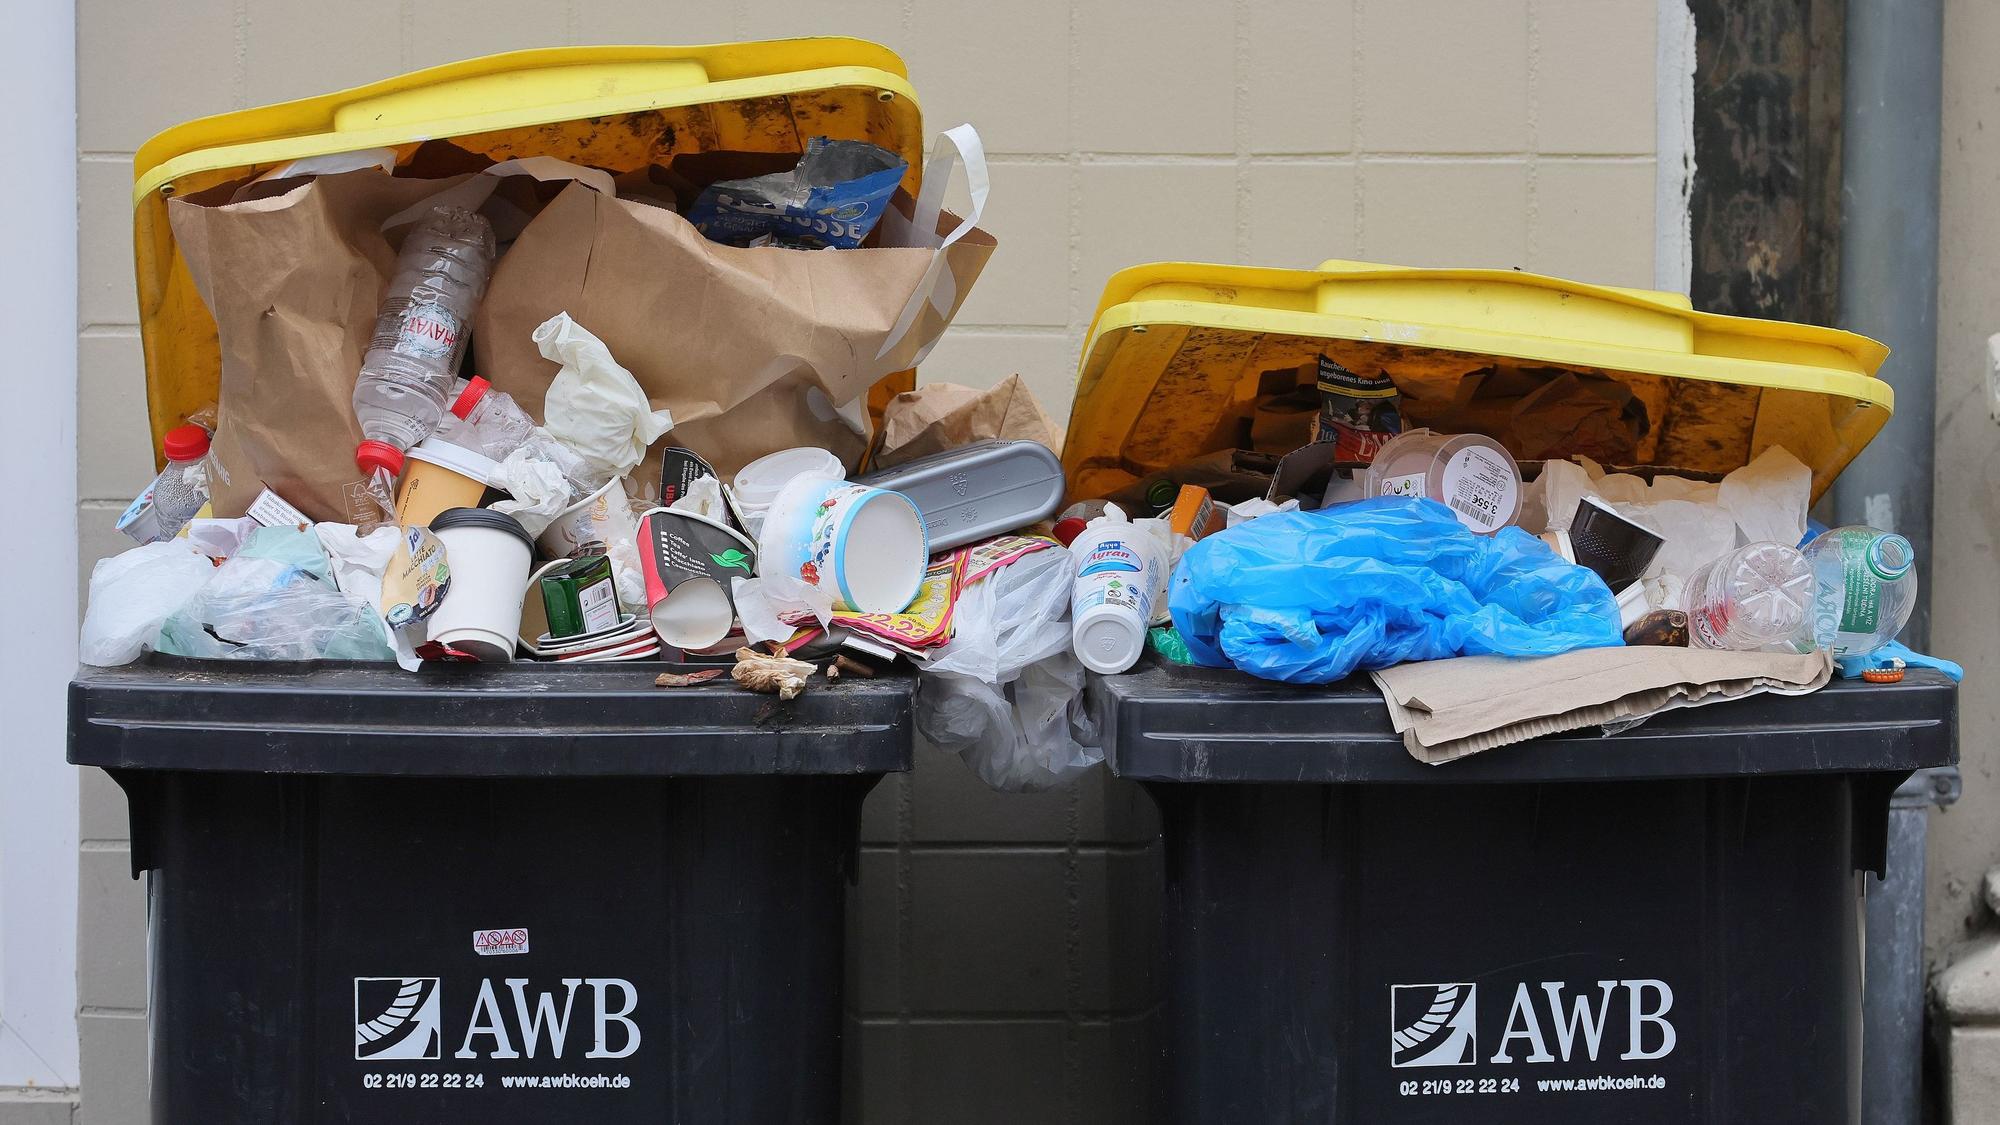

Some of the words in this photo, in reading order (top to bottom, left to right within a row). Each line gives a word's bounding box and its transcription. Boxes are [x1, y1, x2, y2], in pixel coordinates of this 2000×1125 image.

[403, 316, 456, 347] HAYAT
[1319, 369, 1357, 384] ungeborenes
[1471, 494, 1498, 514] 3,55€
[669, 533, 690, 547] Coffee
[669, 540, 681, 549] Tea
[402, 544, 436, 580] MACCHIATO
[1087, 550, 1130, 563] Ayran
[454, 978, 641, 1059] AWB
[1490, 979, 1677, 1063] AWB
[363, 1073, 382, 1088] 02
[386, 1073, 416, 1088] 21/9
[420, 1073, 439, 1088] 22
[443, 1073, 461, 1088] 22
[465, 1073, 484, 1088] 24
[501, 1073, 631, 1088] www.awbkoeln.de
[1400, 1080, 1418, 1095] 02
[1422, 1079, 1452, 1095] 21/9
[1456, 1079, 1474, 1094] 22
[1479, 1078, 1497, 1093] 22
[1501, 1078, 1520, 1093] 24
[1537, 1074, 1666, 1092] www.awbkoeln.de
